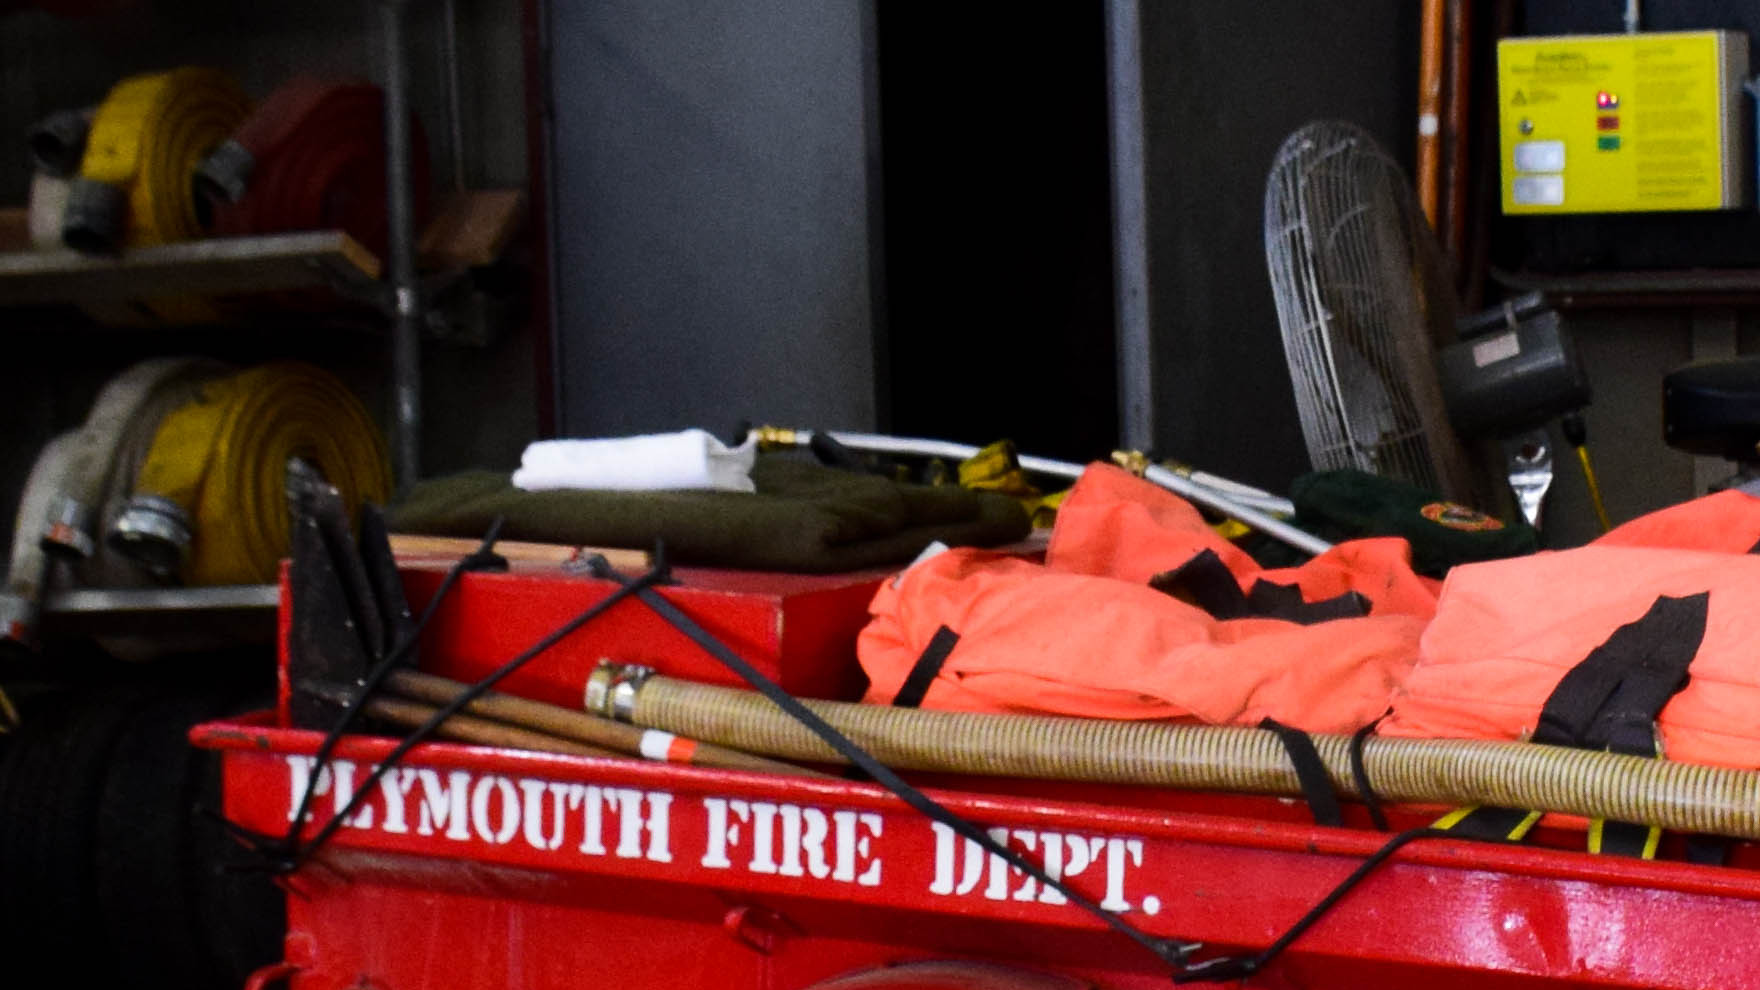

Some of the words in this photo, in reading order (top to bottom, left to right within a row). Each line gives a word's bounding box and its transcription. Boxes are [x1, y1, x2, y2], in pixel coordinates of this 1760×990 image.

[286, 754, 674, 863] PLYMOUTH
[702, 798, 883, 886] FIRE
[929, 820, 1161, 915] DEPT.
